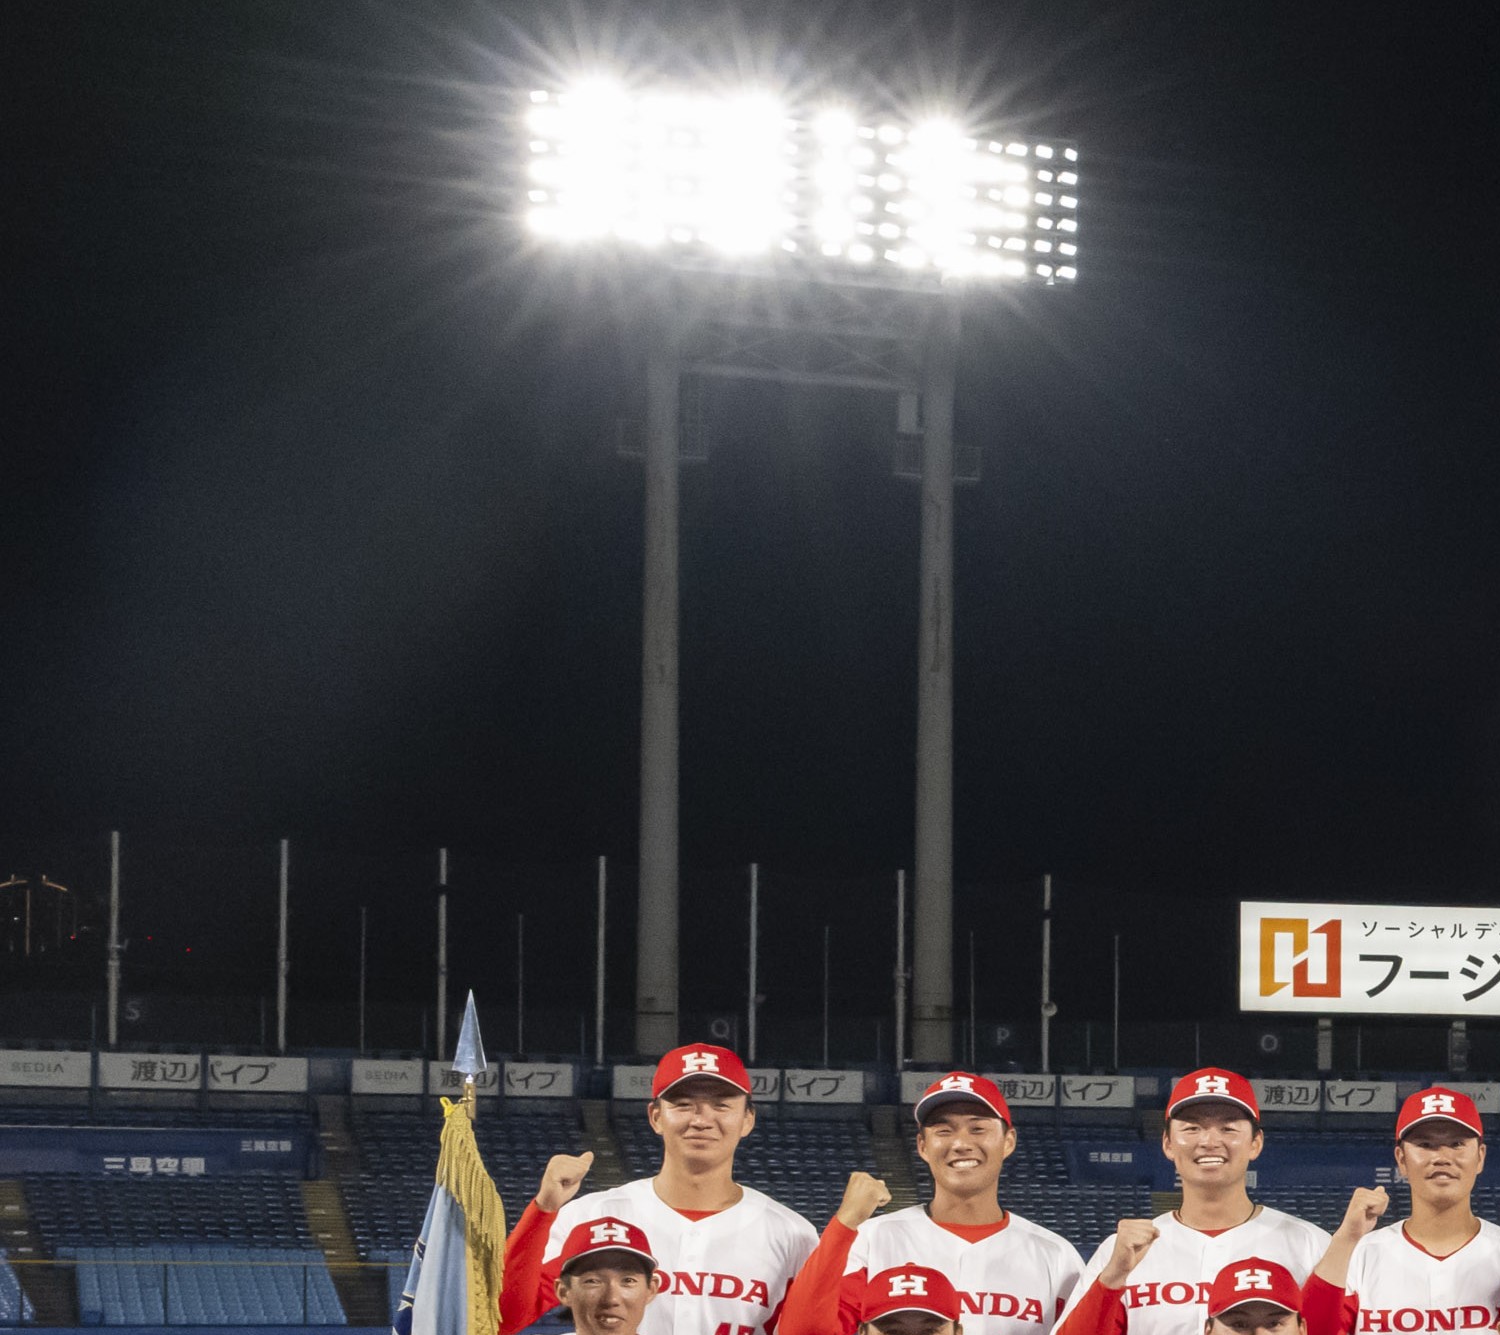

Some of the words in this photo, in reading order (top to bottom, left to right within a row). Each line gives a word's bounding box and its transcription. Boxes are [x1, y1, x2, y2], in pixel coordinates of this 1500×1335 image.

[131, 1060, 276, 1085] 渡辺パイプ
[681, 1052, 720, 1075] H
[1263, 1084, 1382, 1106] 渡辺パイプ
[590, 1220, 633, 1244] H
[654, 1270, 770, 1308] ONDA
[888, 1274, 928, 1297] H
[1127, 1281, 1214, 1309] HON
[957, 1291, 1044, 1324] NDA
